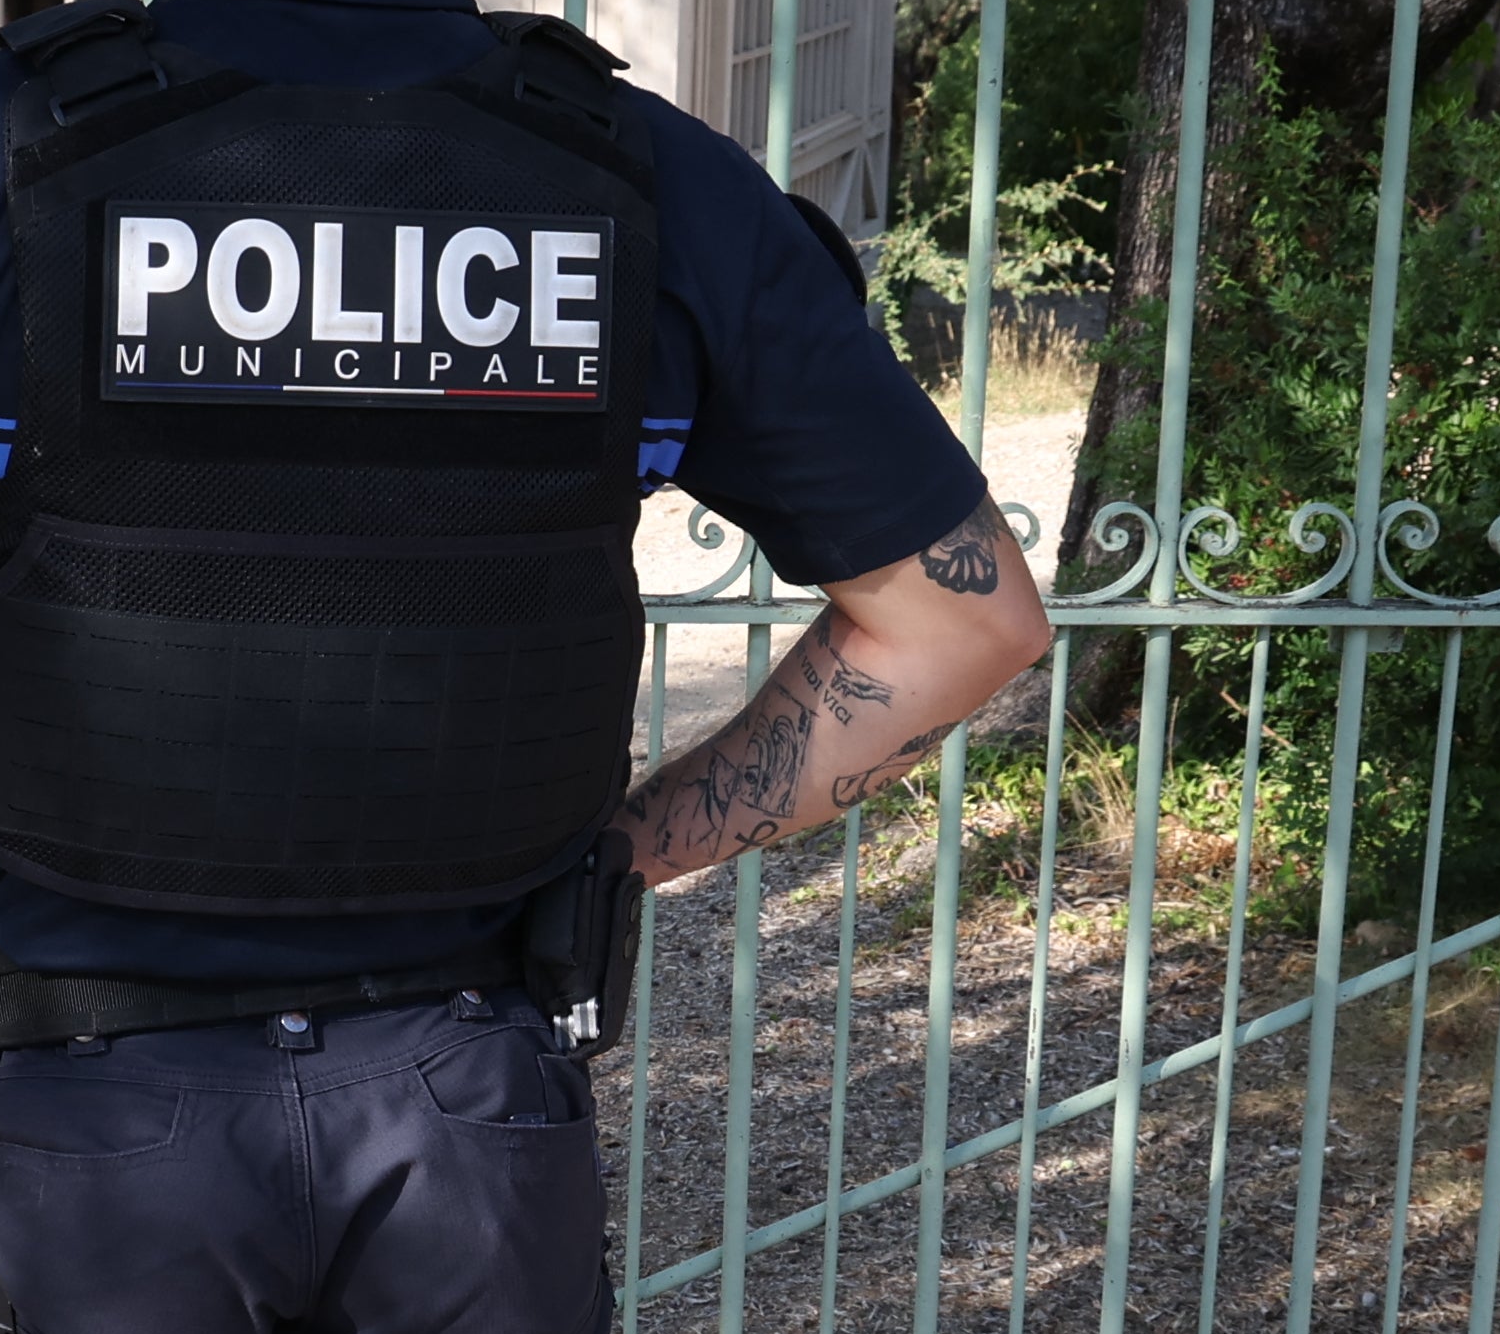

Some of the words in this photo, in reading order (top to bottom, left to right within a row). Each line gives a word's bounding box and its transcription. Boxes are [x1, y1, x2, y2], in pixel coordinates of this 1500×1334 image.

[116, 216, 601, 349] POLICE
[115, 343, 599, 386] MUNICIPALE
[801, 655, 822, 691] VIDI
[823, 689, 853, 725] VICI
